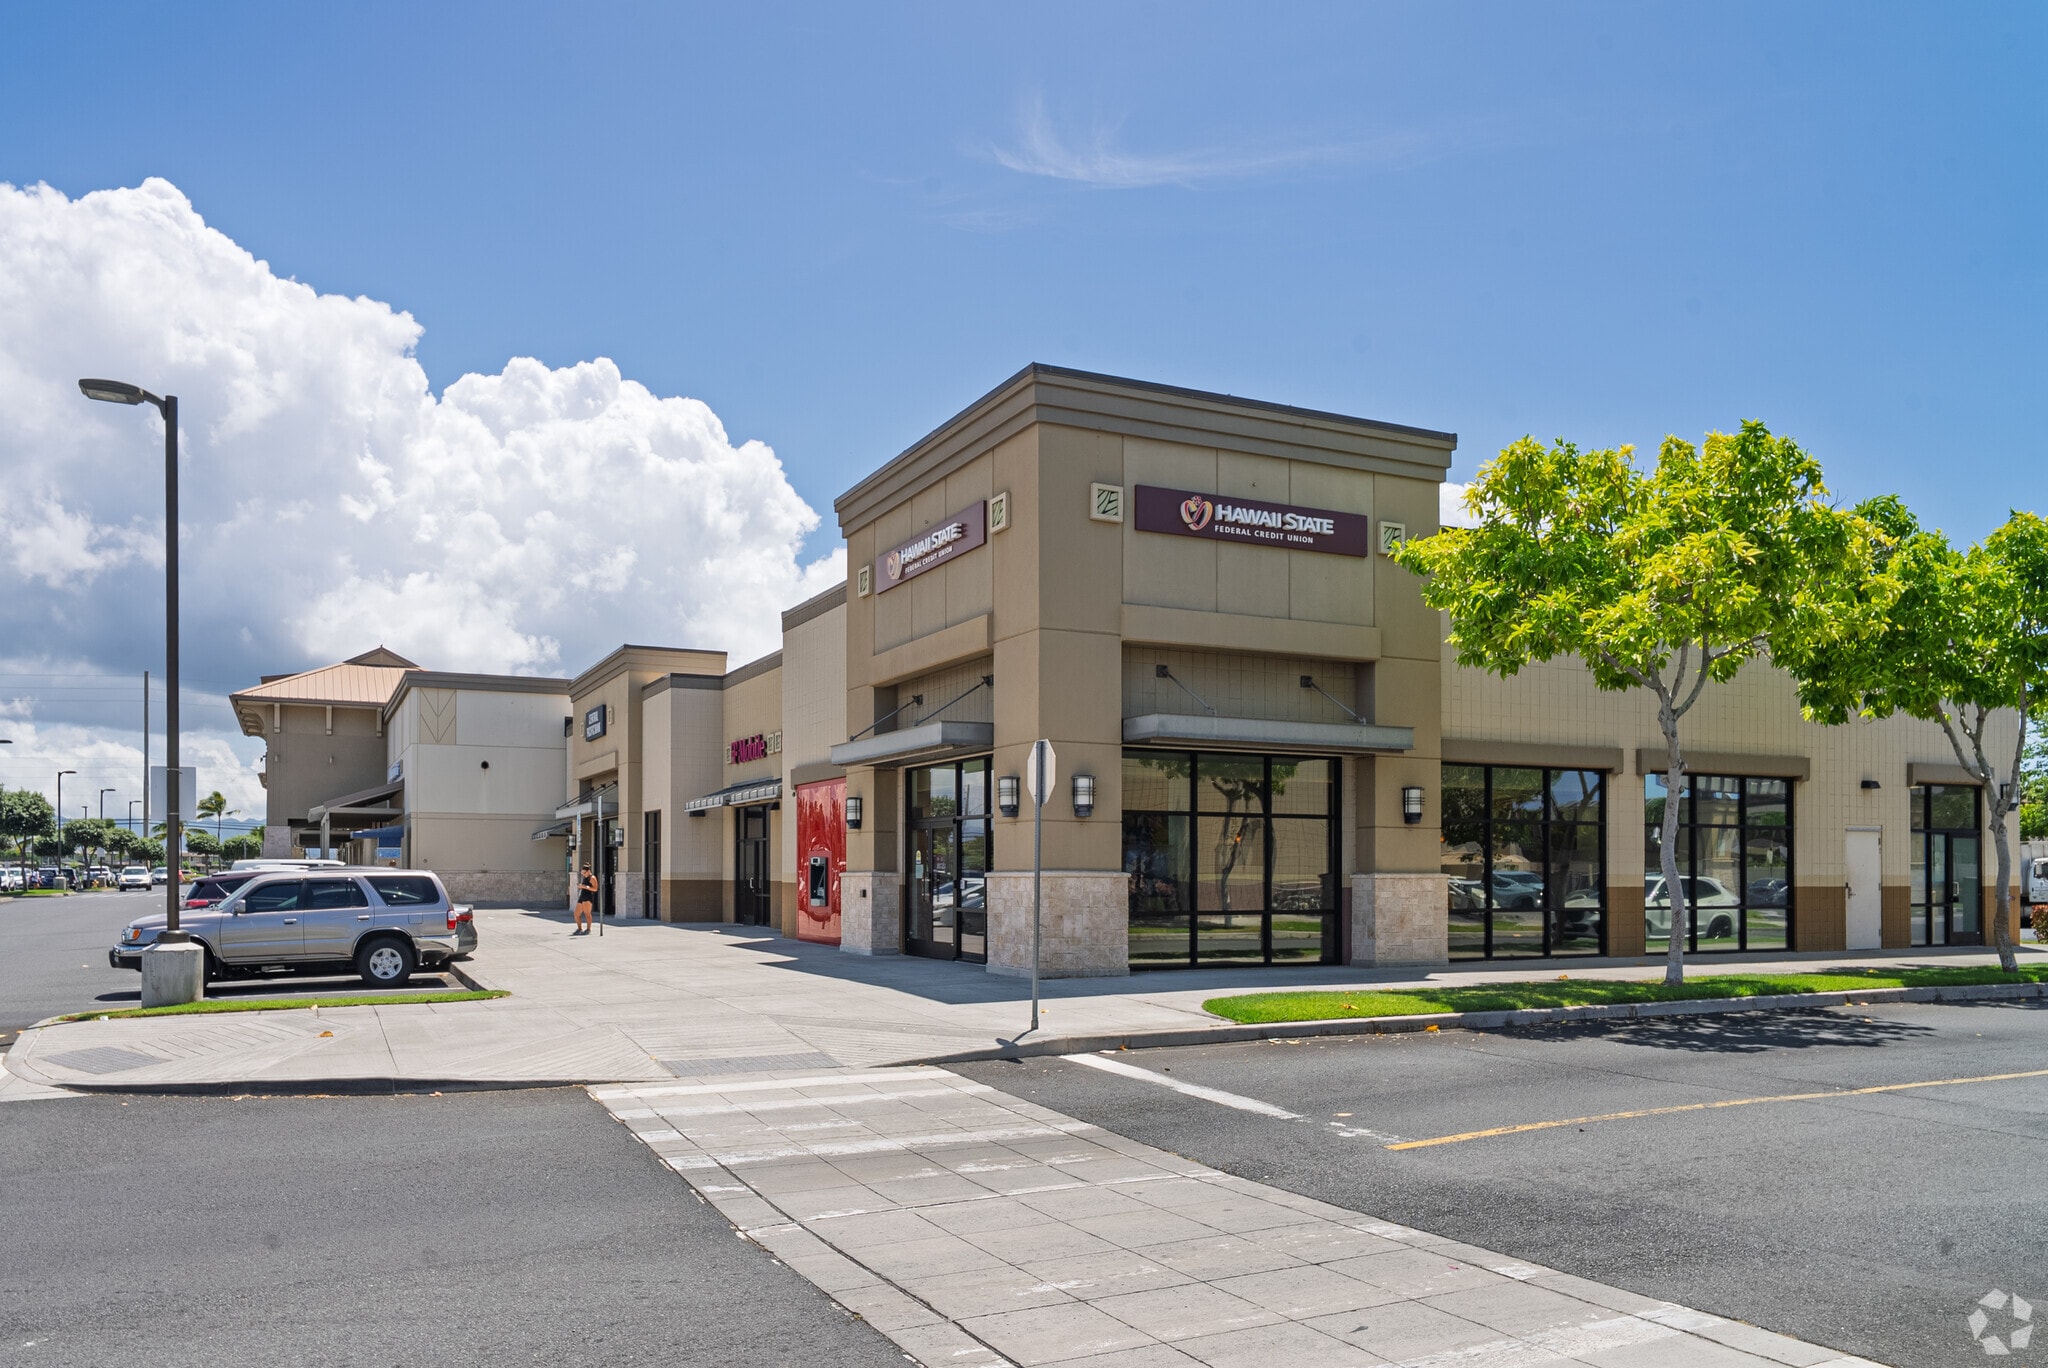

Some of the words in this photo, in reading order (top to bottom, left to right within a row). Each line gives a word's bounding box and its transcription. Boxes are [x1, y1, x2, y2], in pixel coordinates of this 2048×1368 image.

[1215, 504, 1282, 528] HAWAII
[1283, 513, 1334, 535] STATE
[901, 537, 931, 564] HAWAII
[931, 522, 962, 549] STATE
[1215, 525, 1251, 536] FEDERAL
[1254, 530, 1284, 540] CREDIT
[1287, 535, 1314, 544] UNION
[905, 562, 922, 574] FEDERAL
[922, 552, 937, 565] CREDIT
